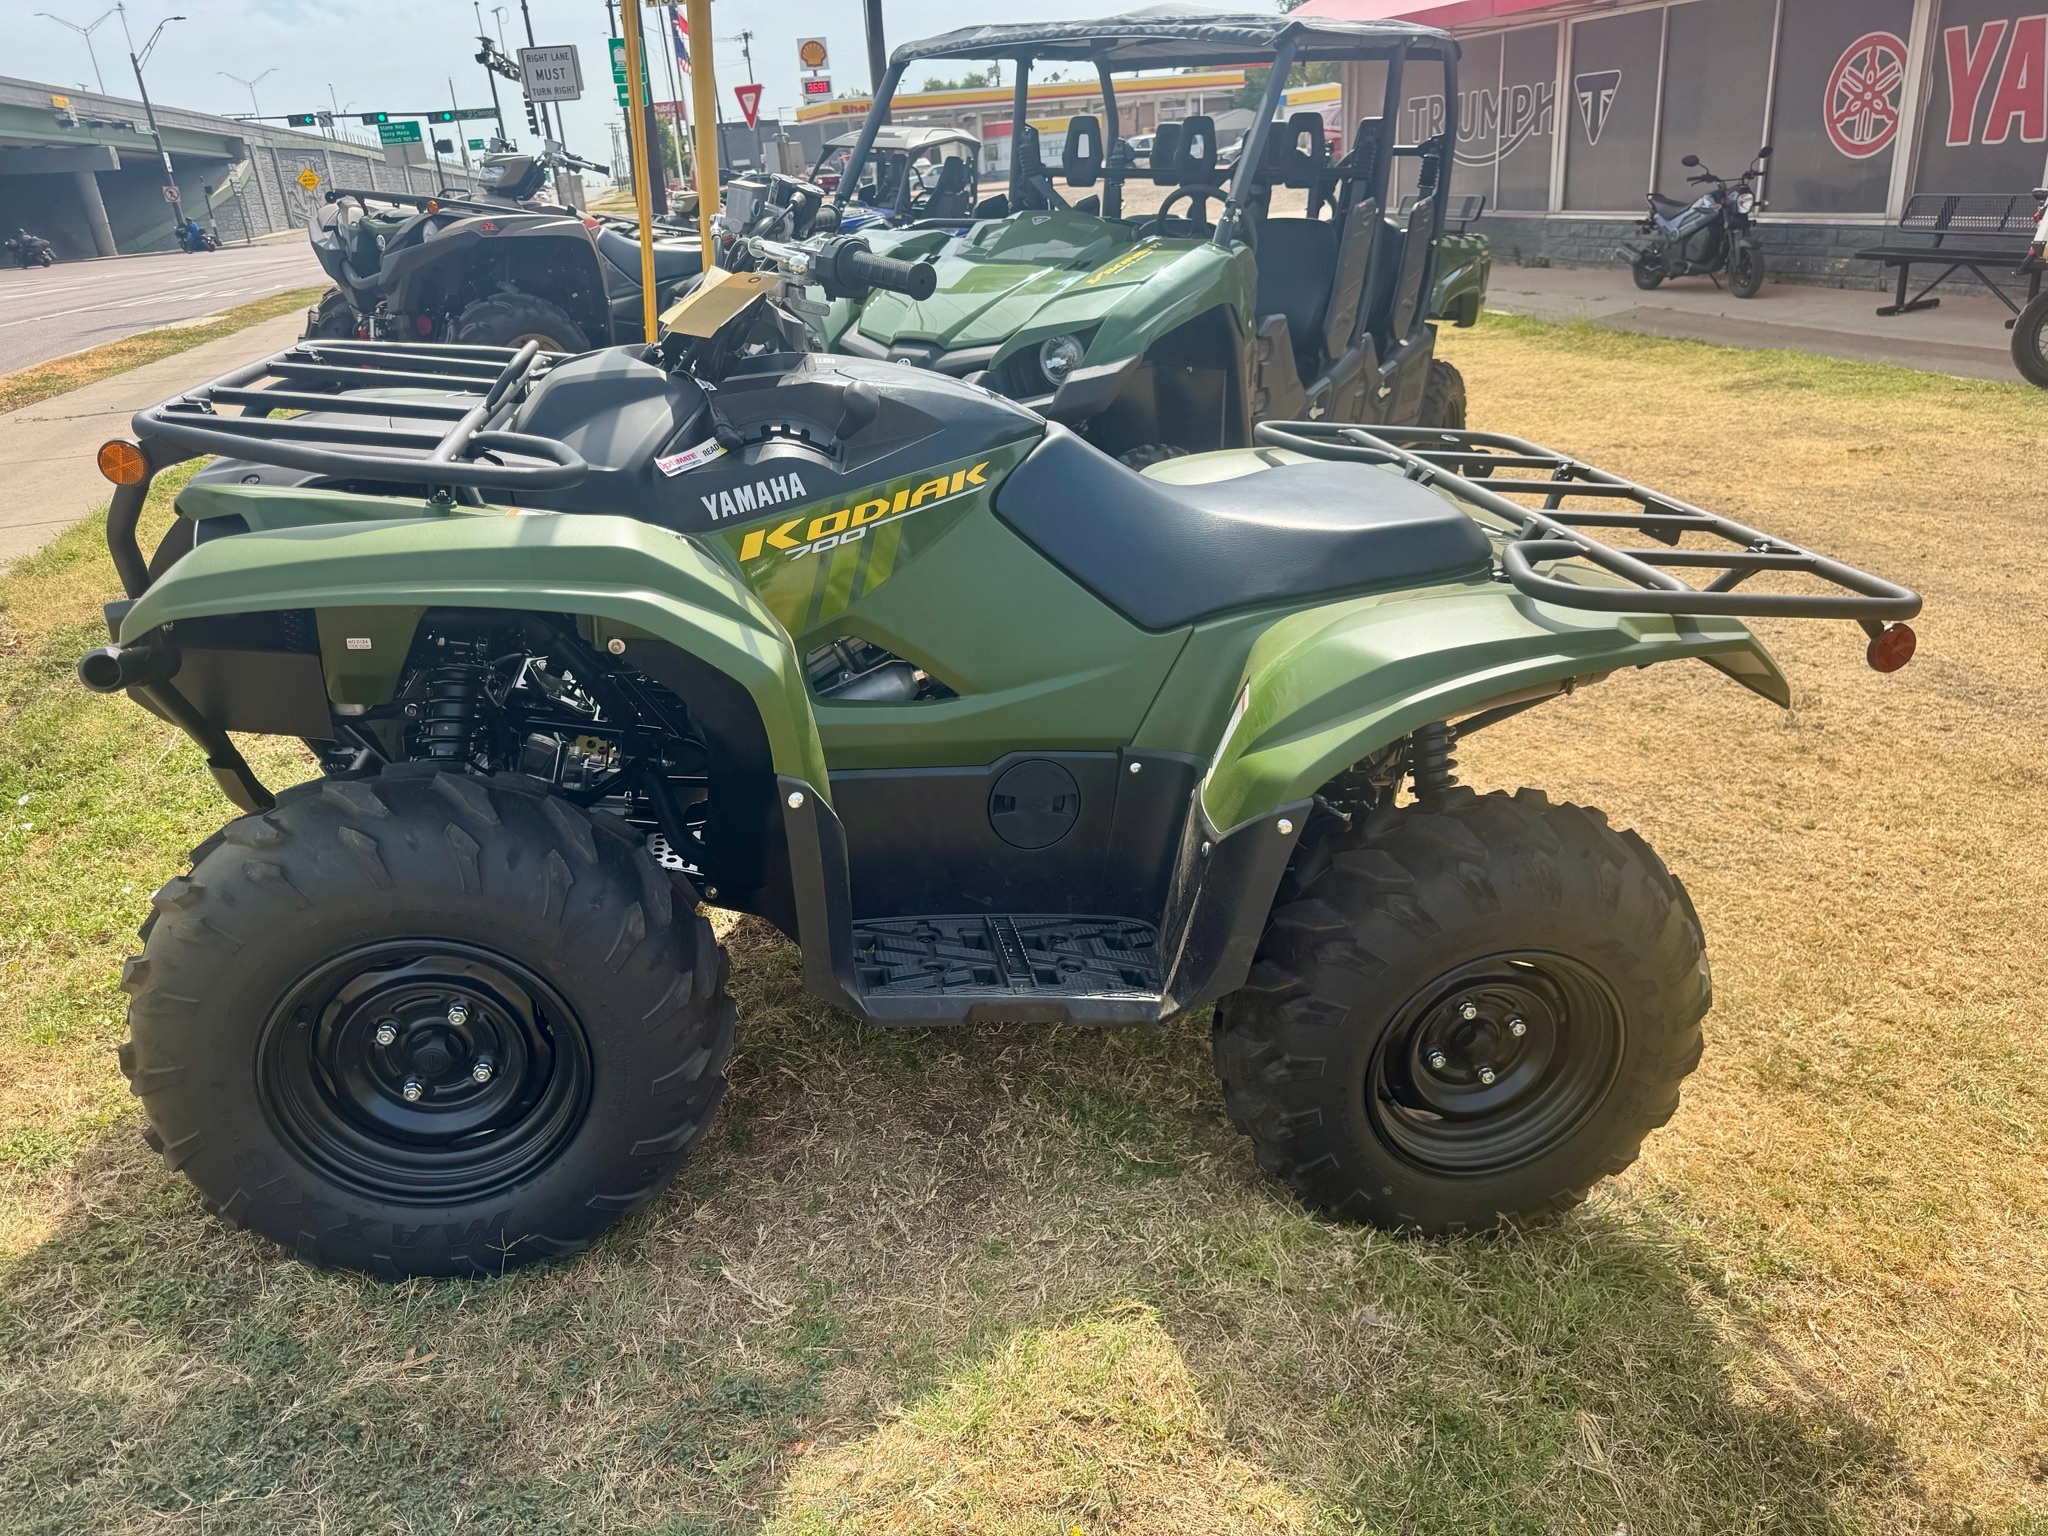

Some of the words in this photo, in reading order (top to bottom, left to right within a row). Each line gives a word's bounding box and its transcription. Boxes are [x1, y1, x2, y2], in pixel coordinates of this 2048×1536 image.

[526, 54, 547, 63] RIGHT
[551, 52, 570, 61] LANE
[535, 68, 565, 81] MUST
[532, 87, 552, 96] TURN
[554, 85, 575, 95] RIGHT
[1408, 81, 1557, 143] TRUMPH
[700, 472, 808, 521] YAMAHA
[739, 461, 990, 562] KODIAK
[785, 526, 867, 561] 700
